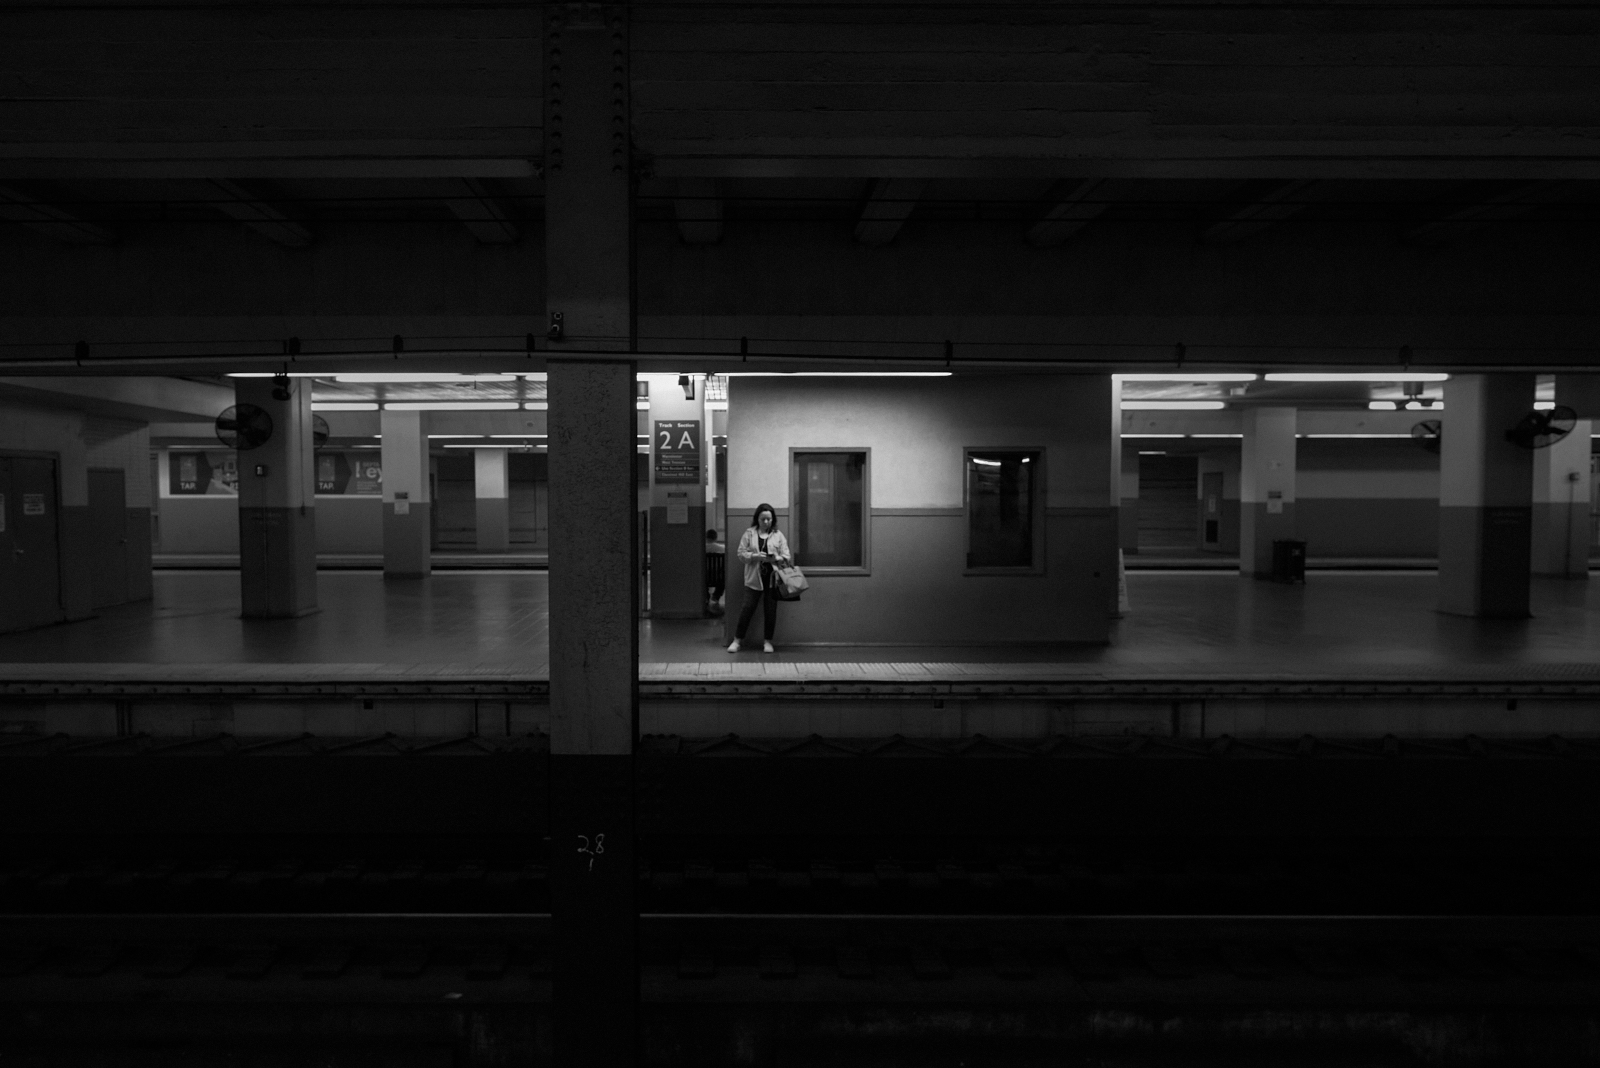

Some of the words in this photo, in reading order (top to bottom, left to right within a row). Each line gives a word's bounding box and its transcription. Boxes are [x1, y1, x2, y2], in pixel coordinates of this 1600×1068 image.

[659, 430, 672, 450] 2
[677, 430, 695, 450] A
[577, 833, 605, 855] 28
